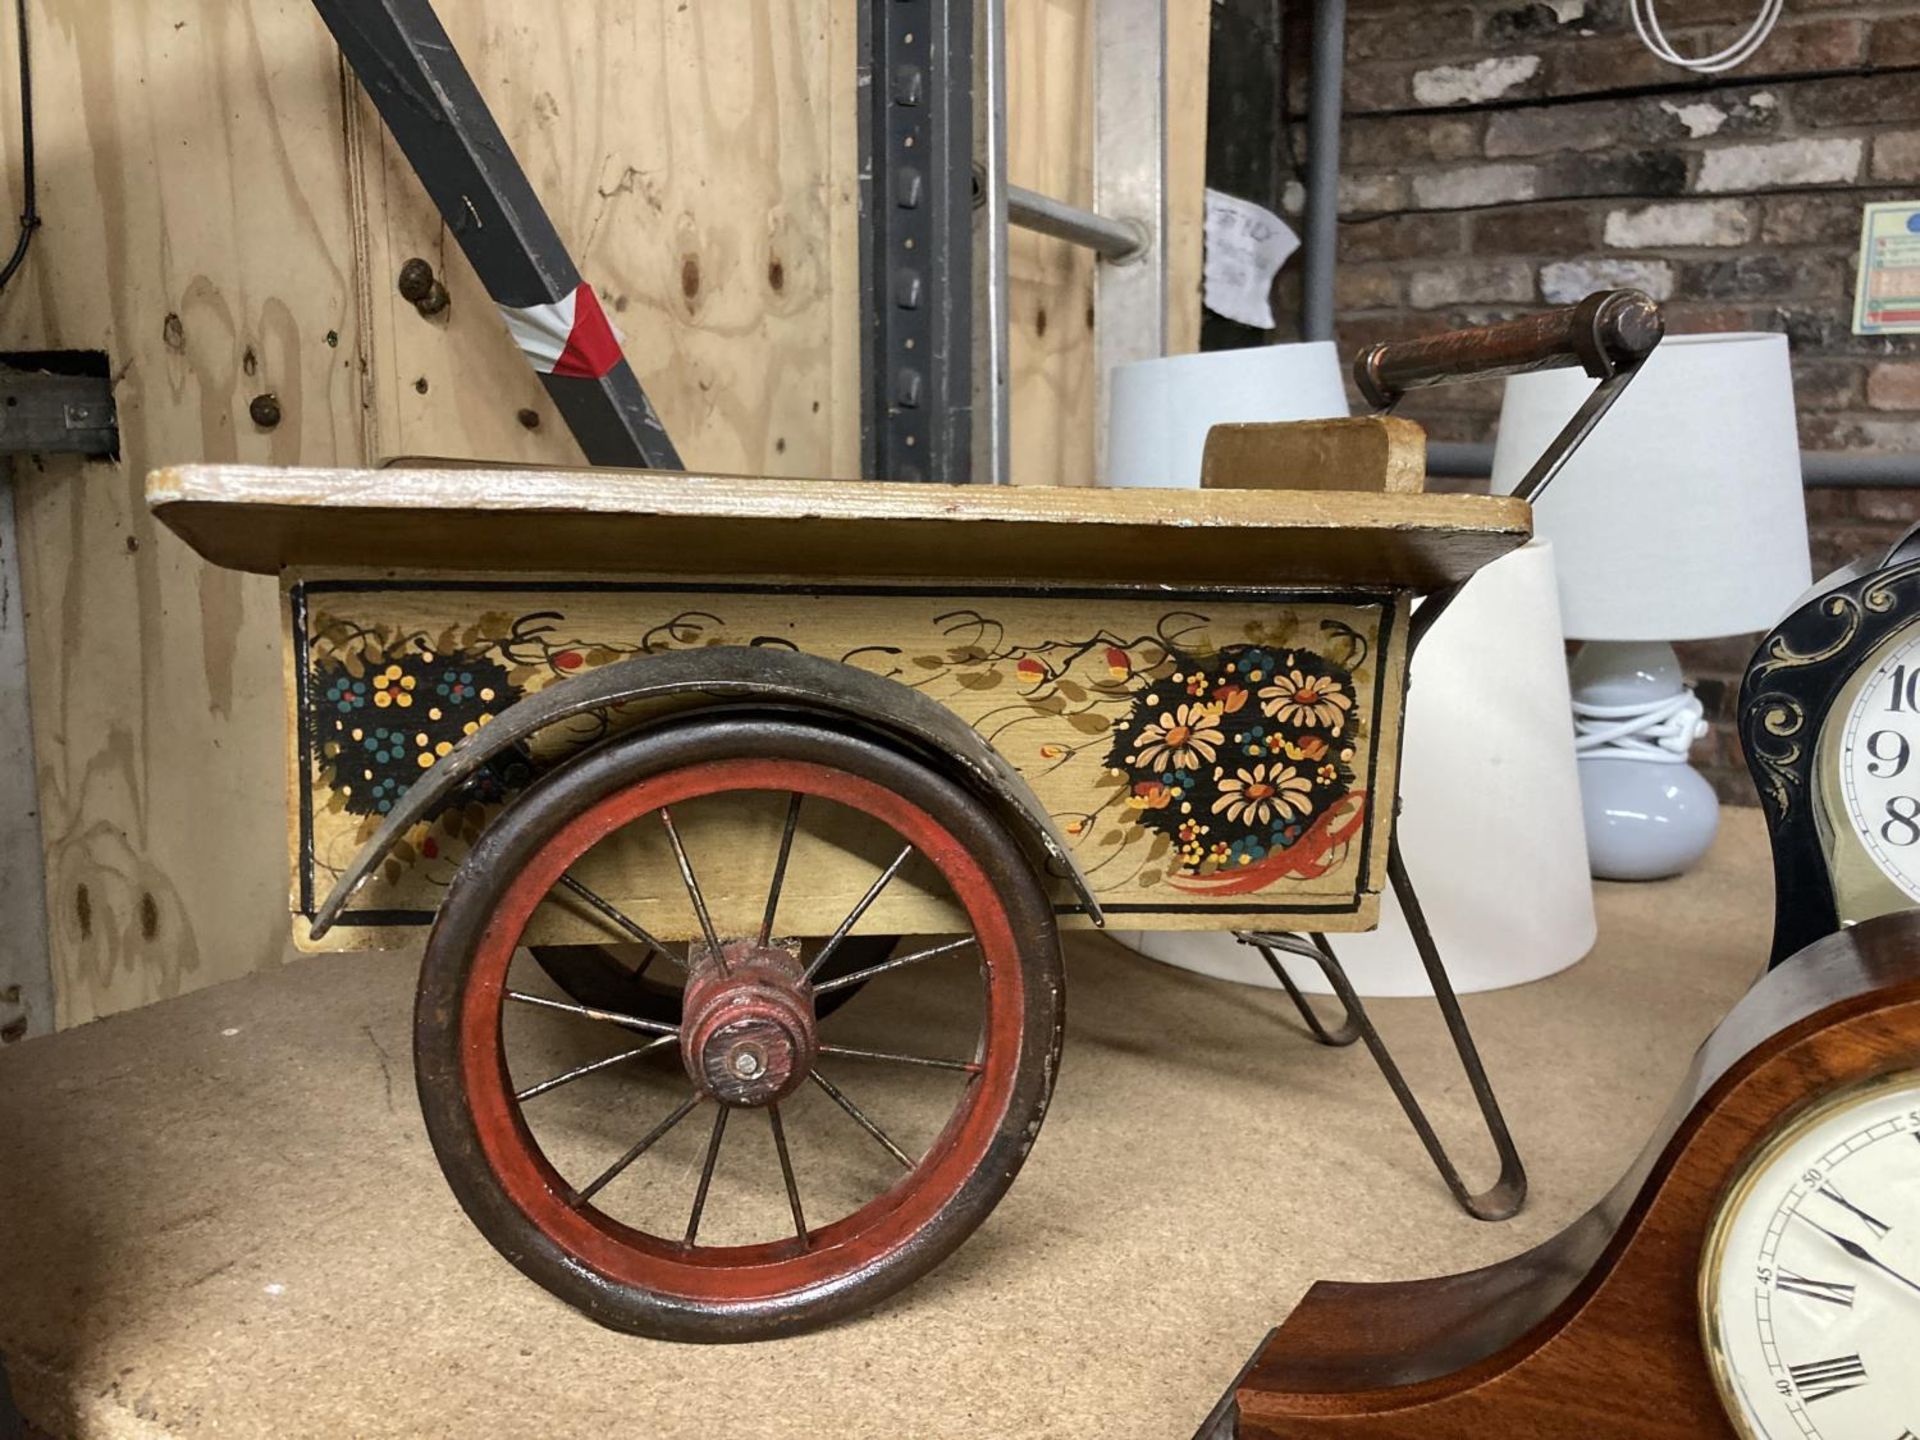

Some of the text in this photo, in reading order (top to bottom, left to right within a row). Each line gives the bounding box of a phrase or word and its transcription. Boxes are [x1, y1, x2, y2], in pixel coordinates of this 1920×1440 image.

[1866, 730, 1911, 779] 9
[1881, 796, 1920, 847] 8
[1801, 1168, 1823, 1189] 50
[1815, 1179, 1893, 1241] X
[1757, 1265, 1773, 1286] 45
[1775, 1264, 1856, 1309] IX
[1775, 1379, 1793, 1398] 40
[1786, 1351, 1871, 1406] VIII
